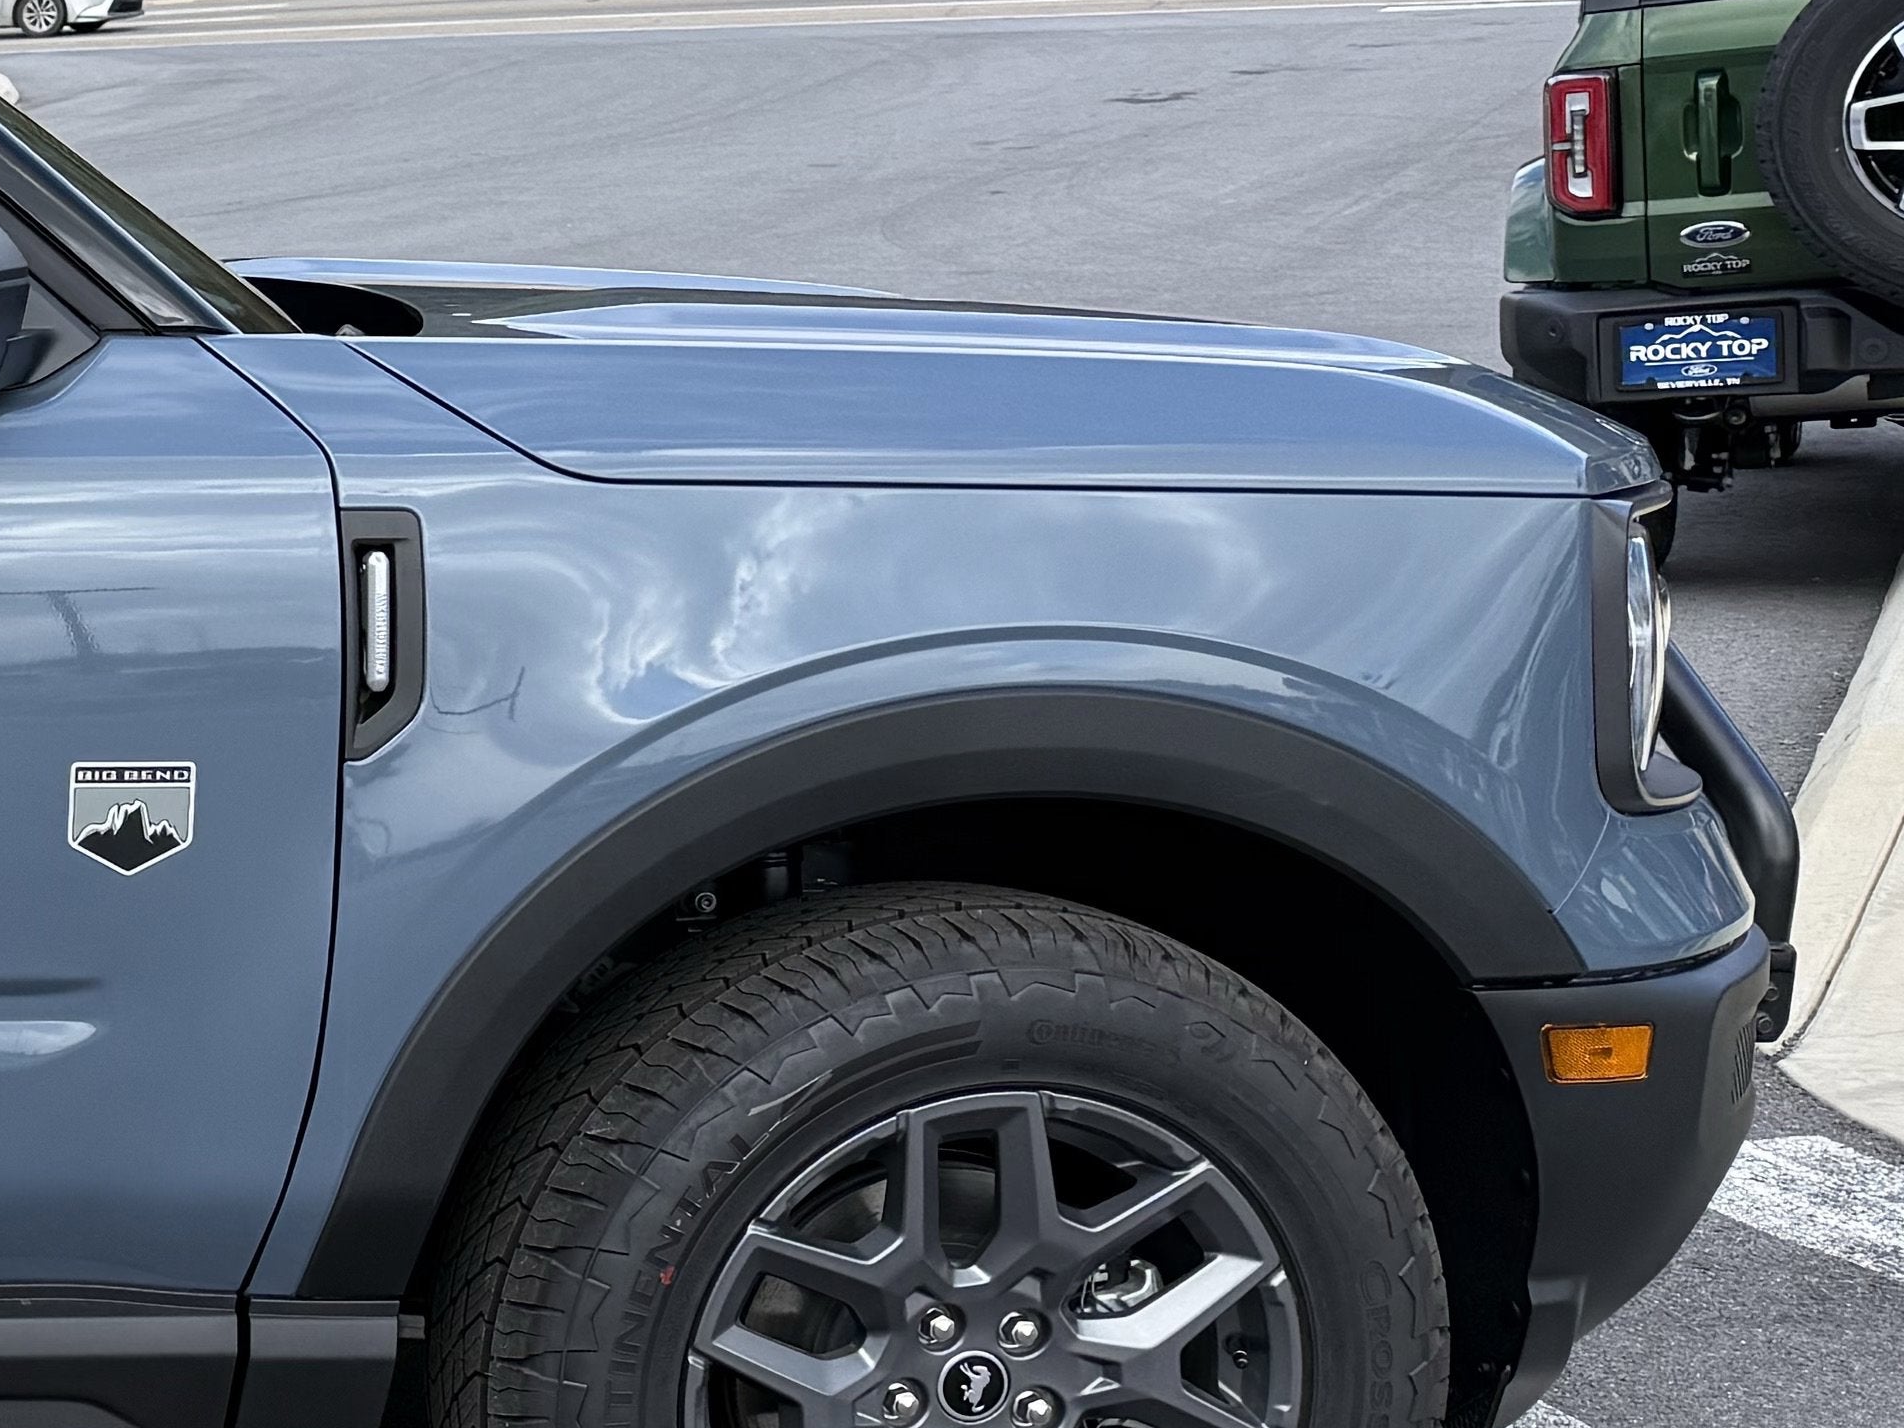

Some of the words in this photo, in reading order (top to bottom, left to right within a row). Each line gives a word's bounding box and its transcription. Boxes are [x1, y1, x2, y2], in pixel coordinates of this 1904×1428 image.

[1683, 261, 1722, 273] ROCKY
[1725, 259, 1751, 269] TOP
[1663, 315, 1703, 327] ROCKY
[1705, 313, 1730, 324] TOP
[1629, 341, 1713, 362] ROCKY
[1716, 338, 1769, 357] TOP
[77, 770, 117, 781] BIG
[124, 770, 190, 781] BEND
